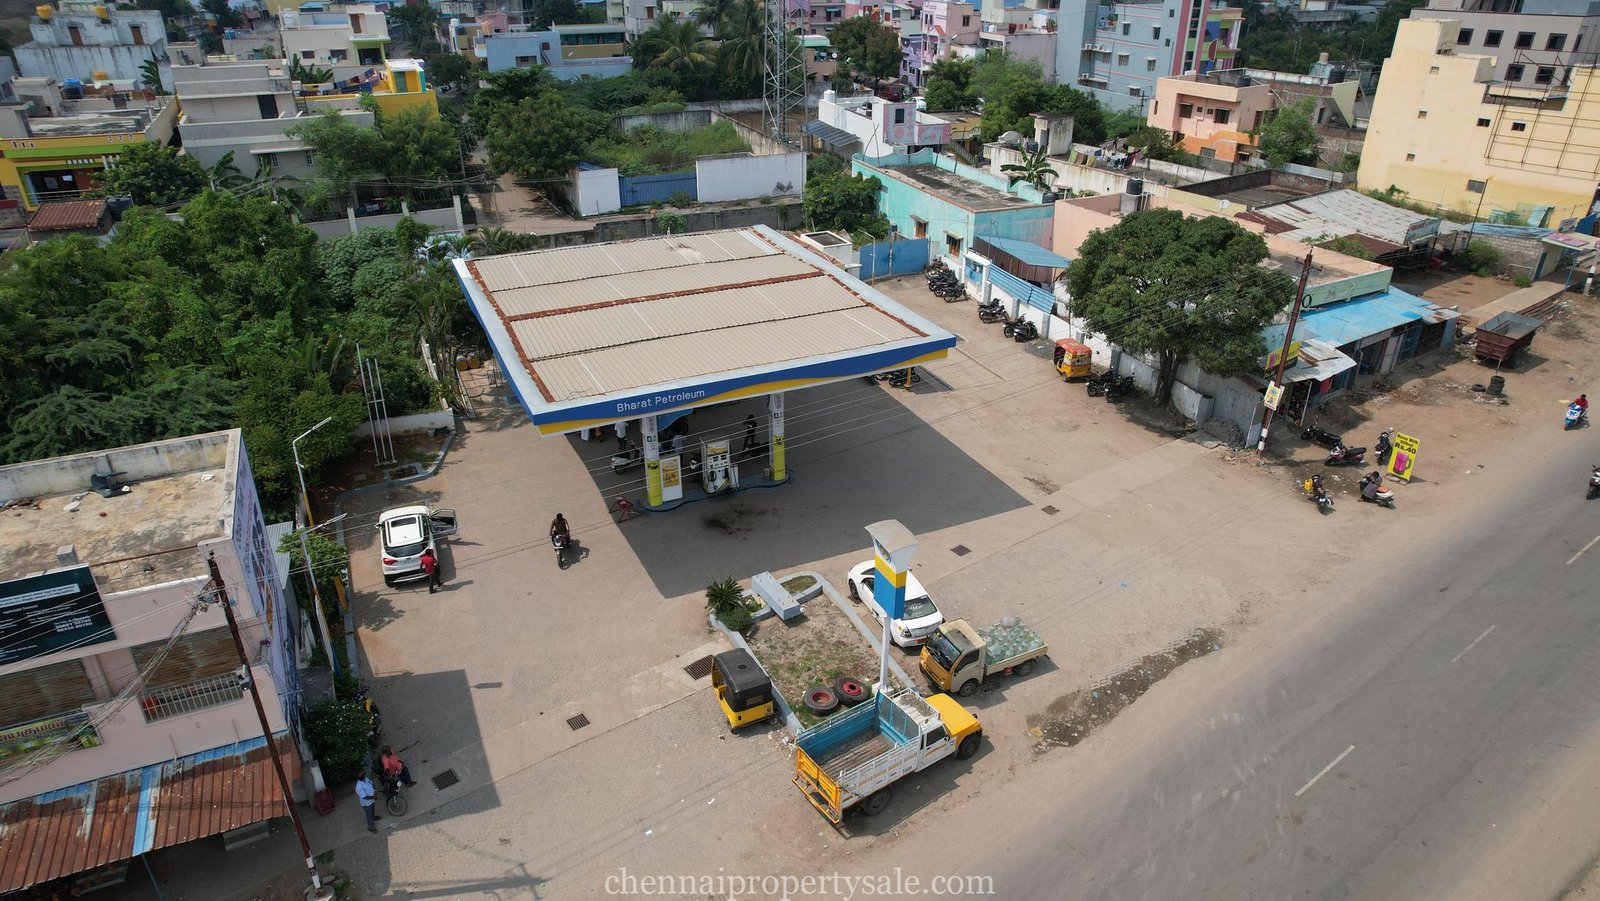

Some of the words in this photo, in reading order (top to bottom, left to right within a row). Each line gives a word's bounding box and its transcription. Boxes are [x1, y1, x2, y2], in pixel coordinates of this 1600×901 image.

[617, 398, 652, 413] Bharat
[655, 389, 705, 405] Petroleum
[1394, 442, 1417, 454] Rs.40
